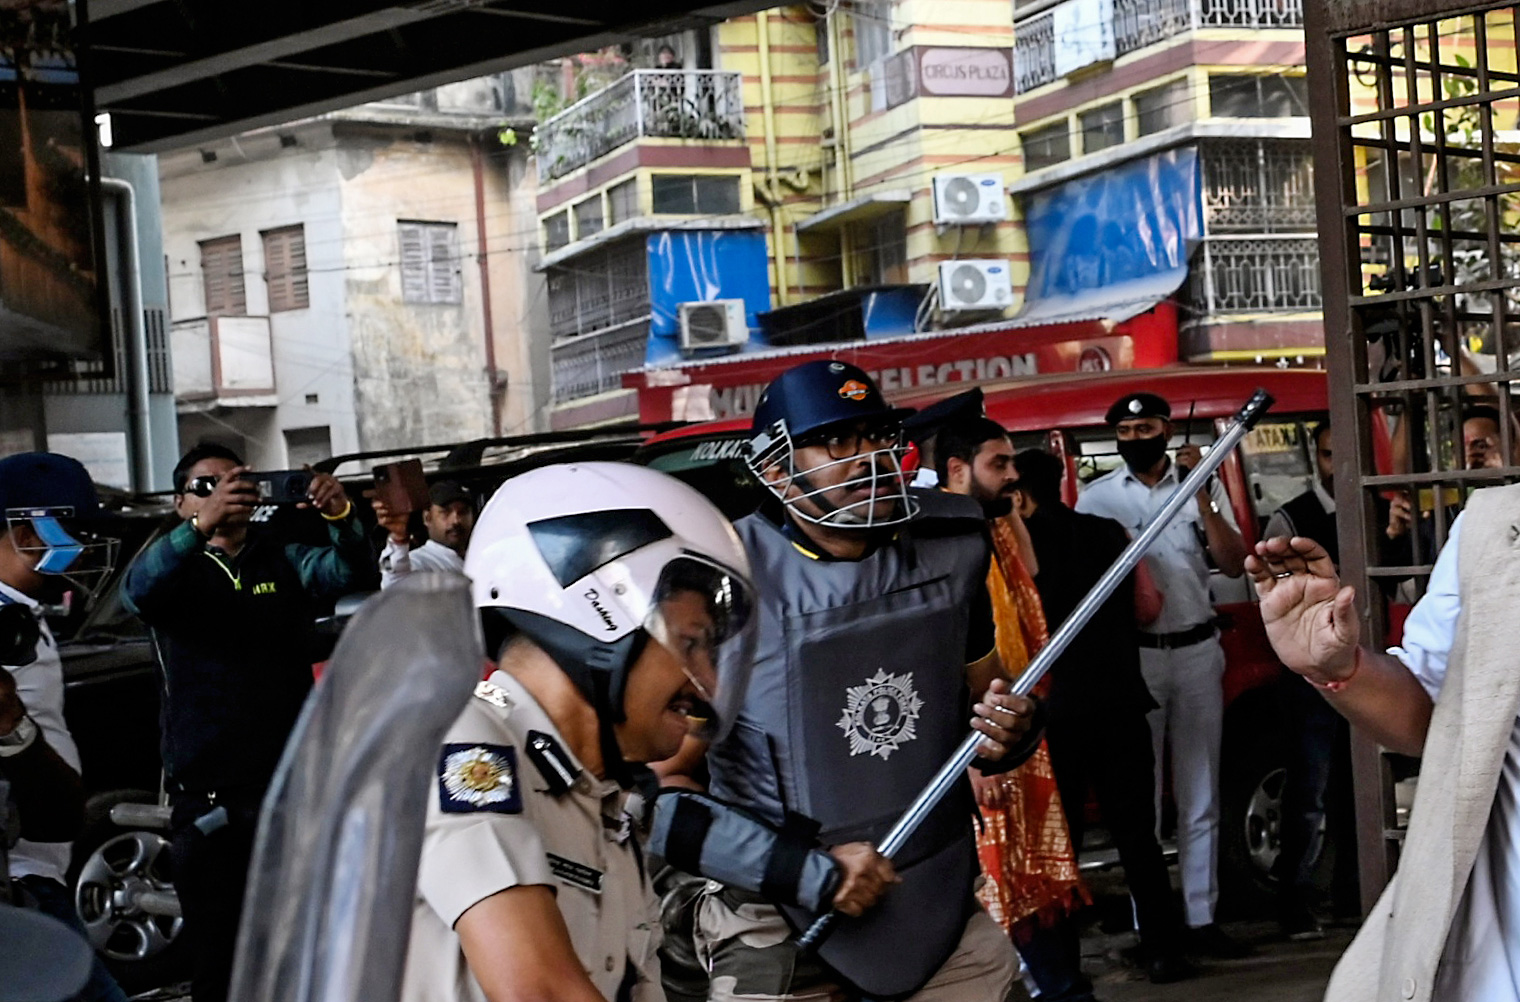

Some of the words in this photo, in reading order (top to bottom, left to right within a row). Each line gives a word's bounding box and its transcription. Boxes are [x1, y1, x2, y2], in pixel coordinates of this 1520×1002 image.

[924, 63, 967, 79] CIRCUS
[969, 64, 1007, 80] PLAZA
[583, 587, 618, 632] Dashing
